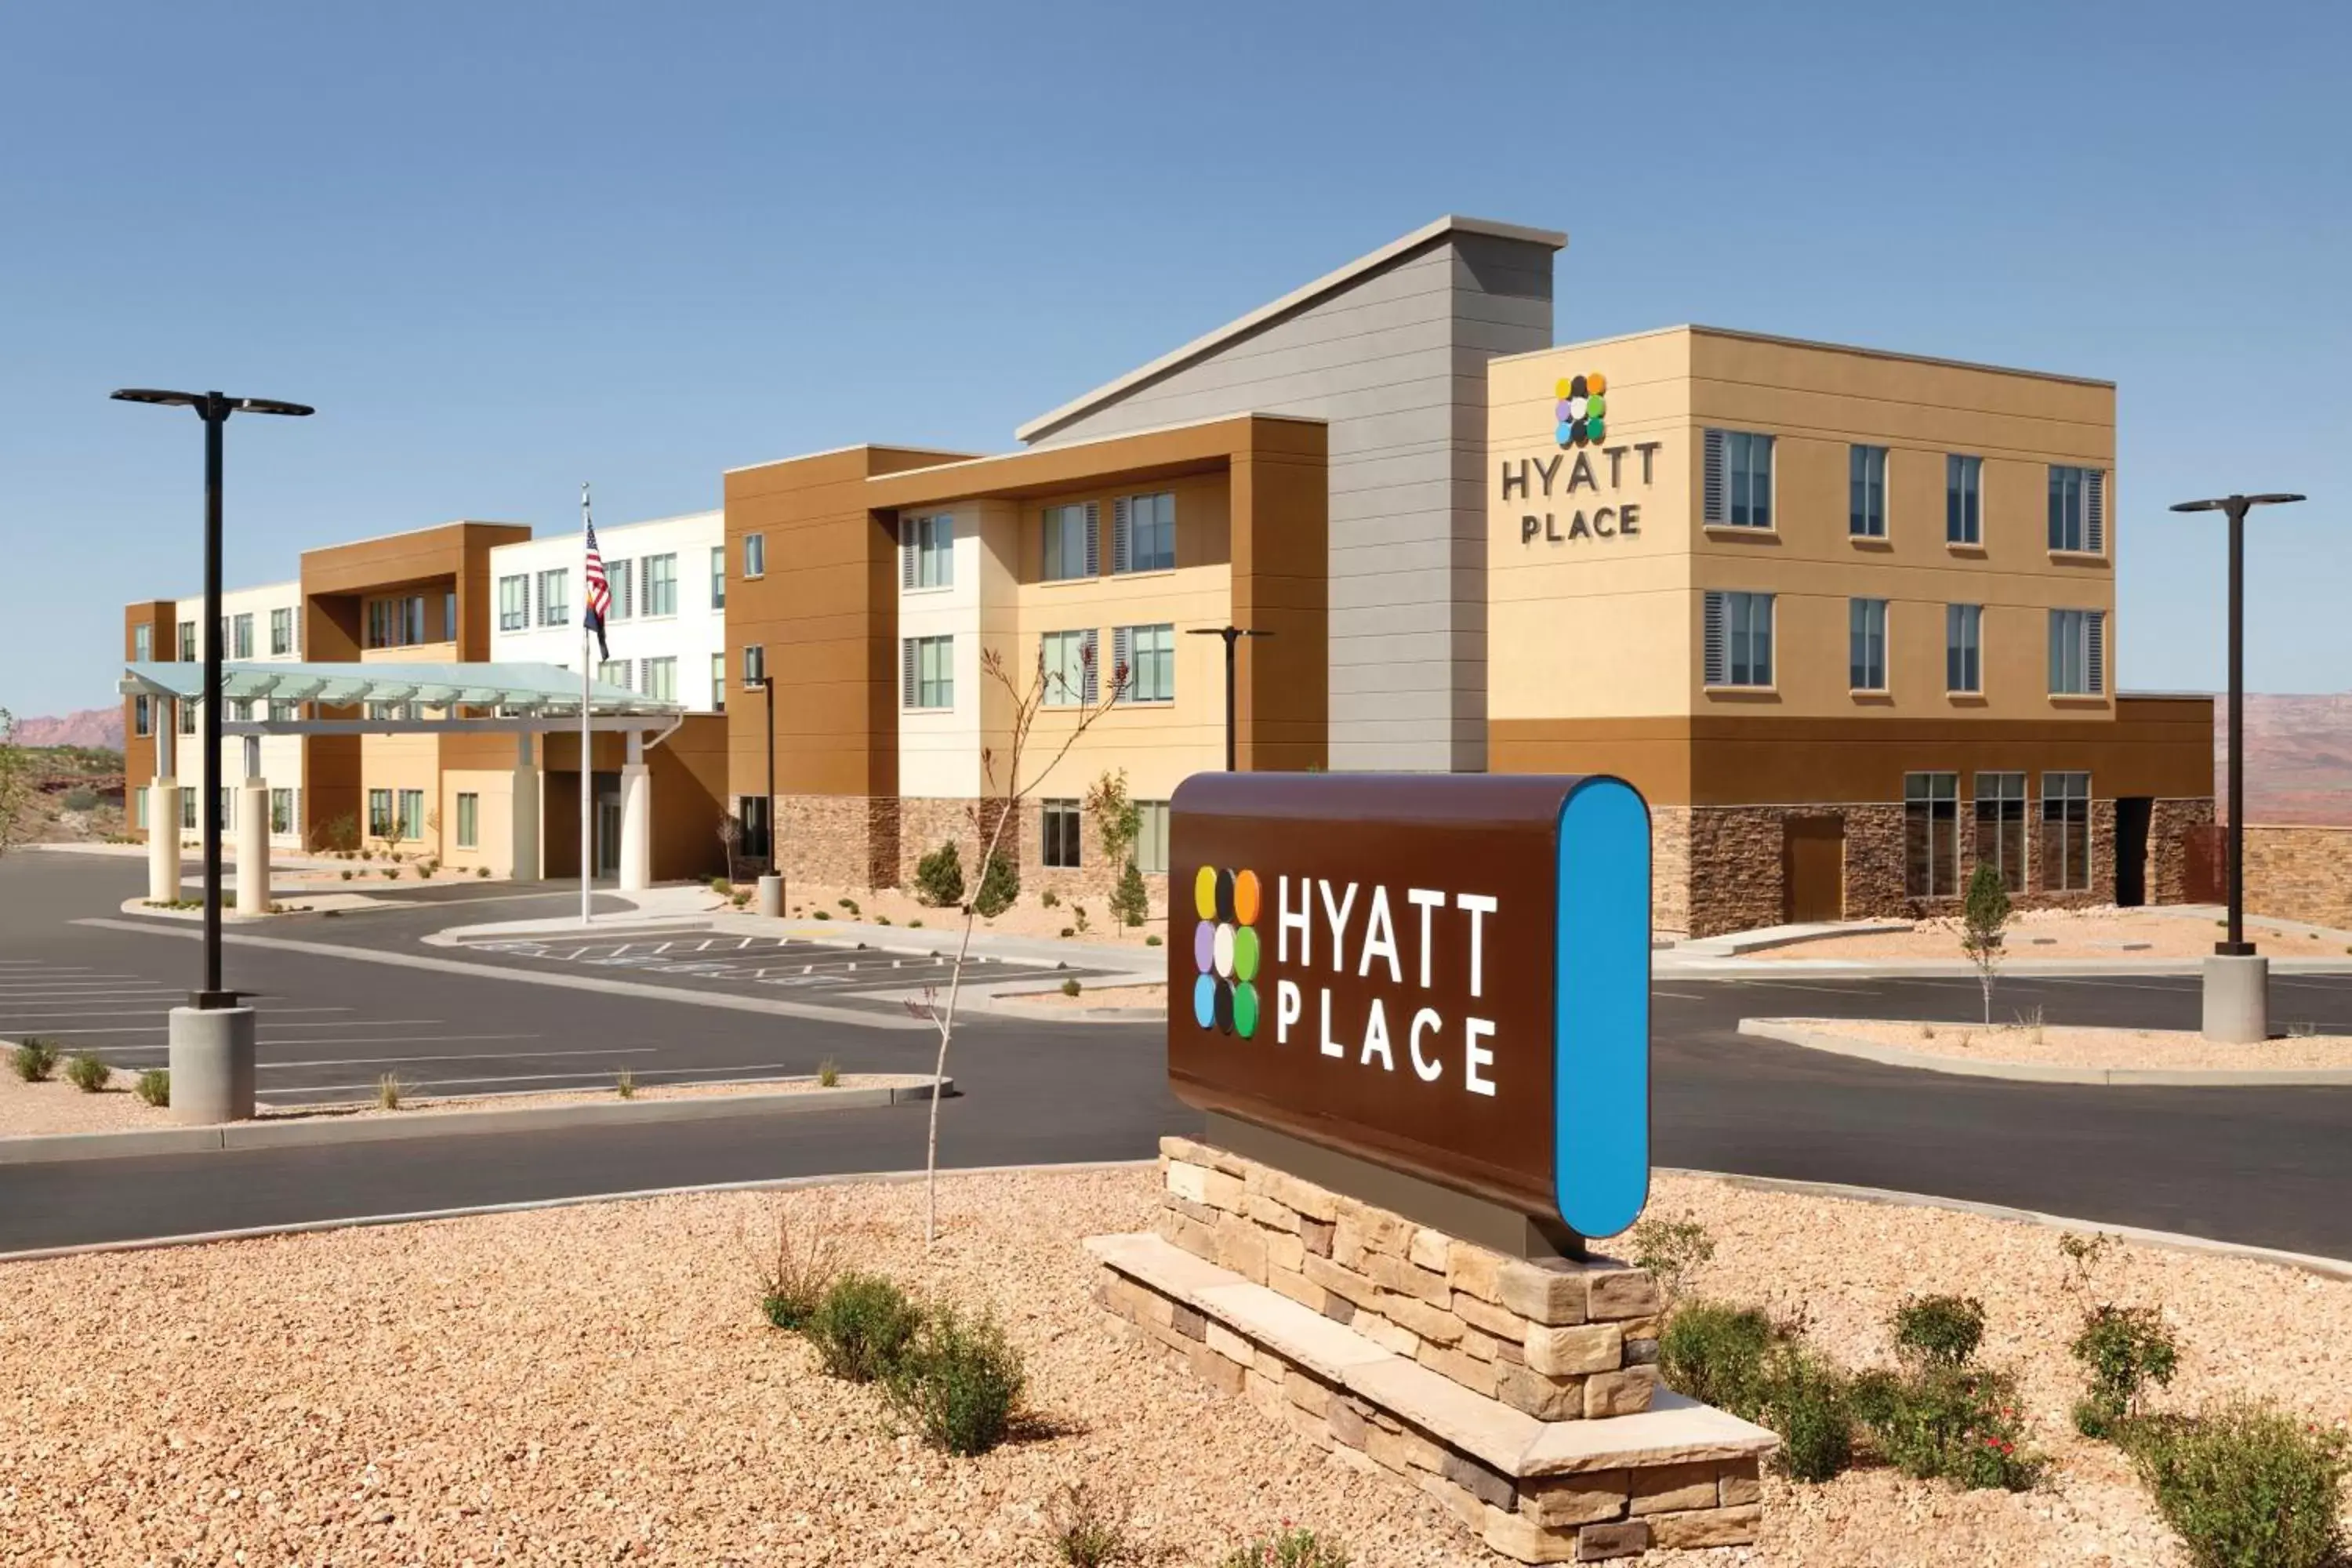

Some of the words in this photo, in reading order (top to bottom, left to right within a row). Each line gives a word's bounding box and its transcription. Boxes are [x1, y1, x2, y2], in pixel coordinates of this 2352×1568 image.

[1502, 441, 1661, 500] HYATT
[1522, 504, 1640, 544] PLACE
[1279, 876, 1497, 997] HYATT
[1277, 980, 1496, 1096] PLACE
